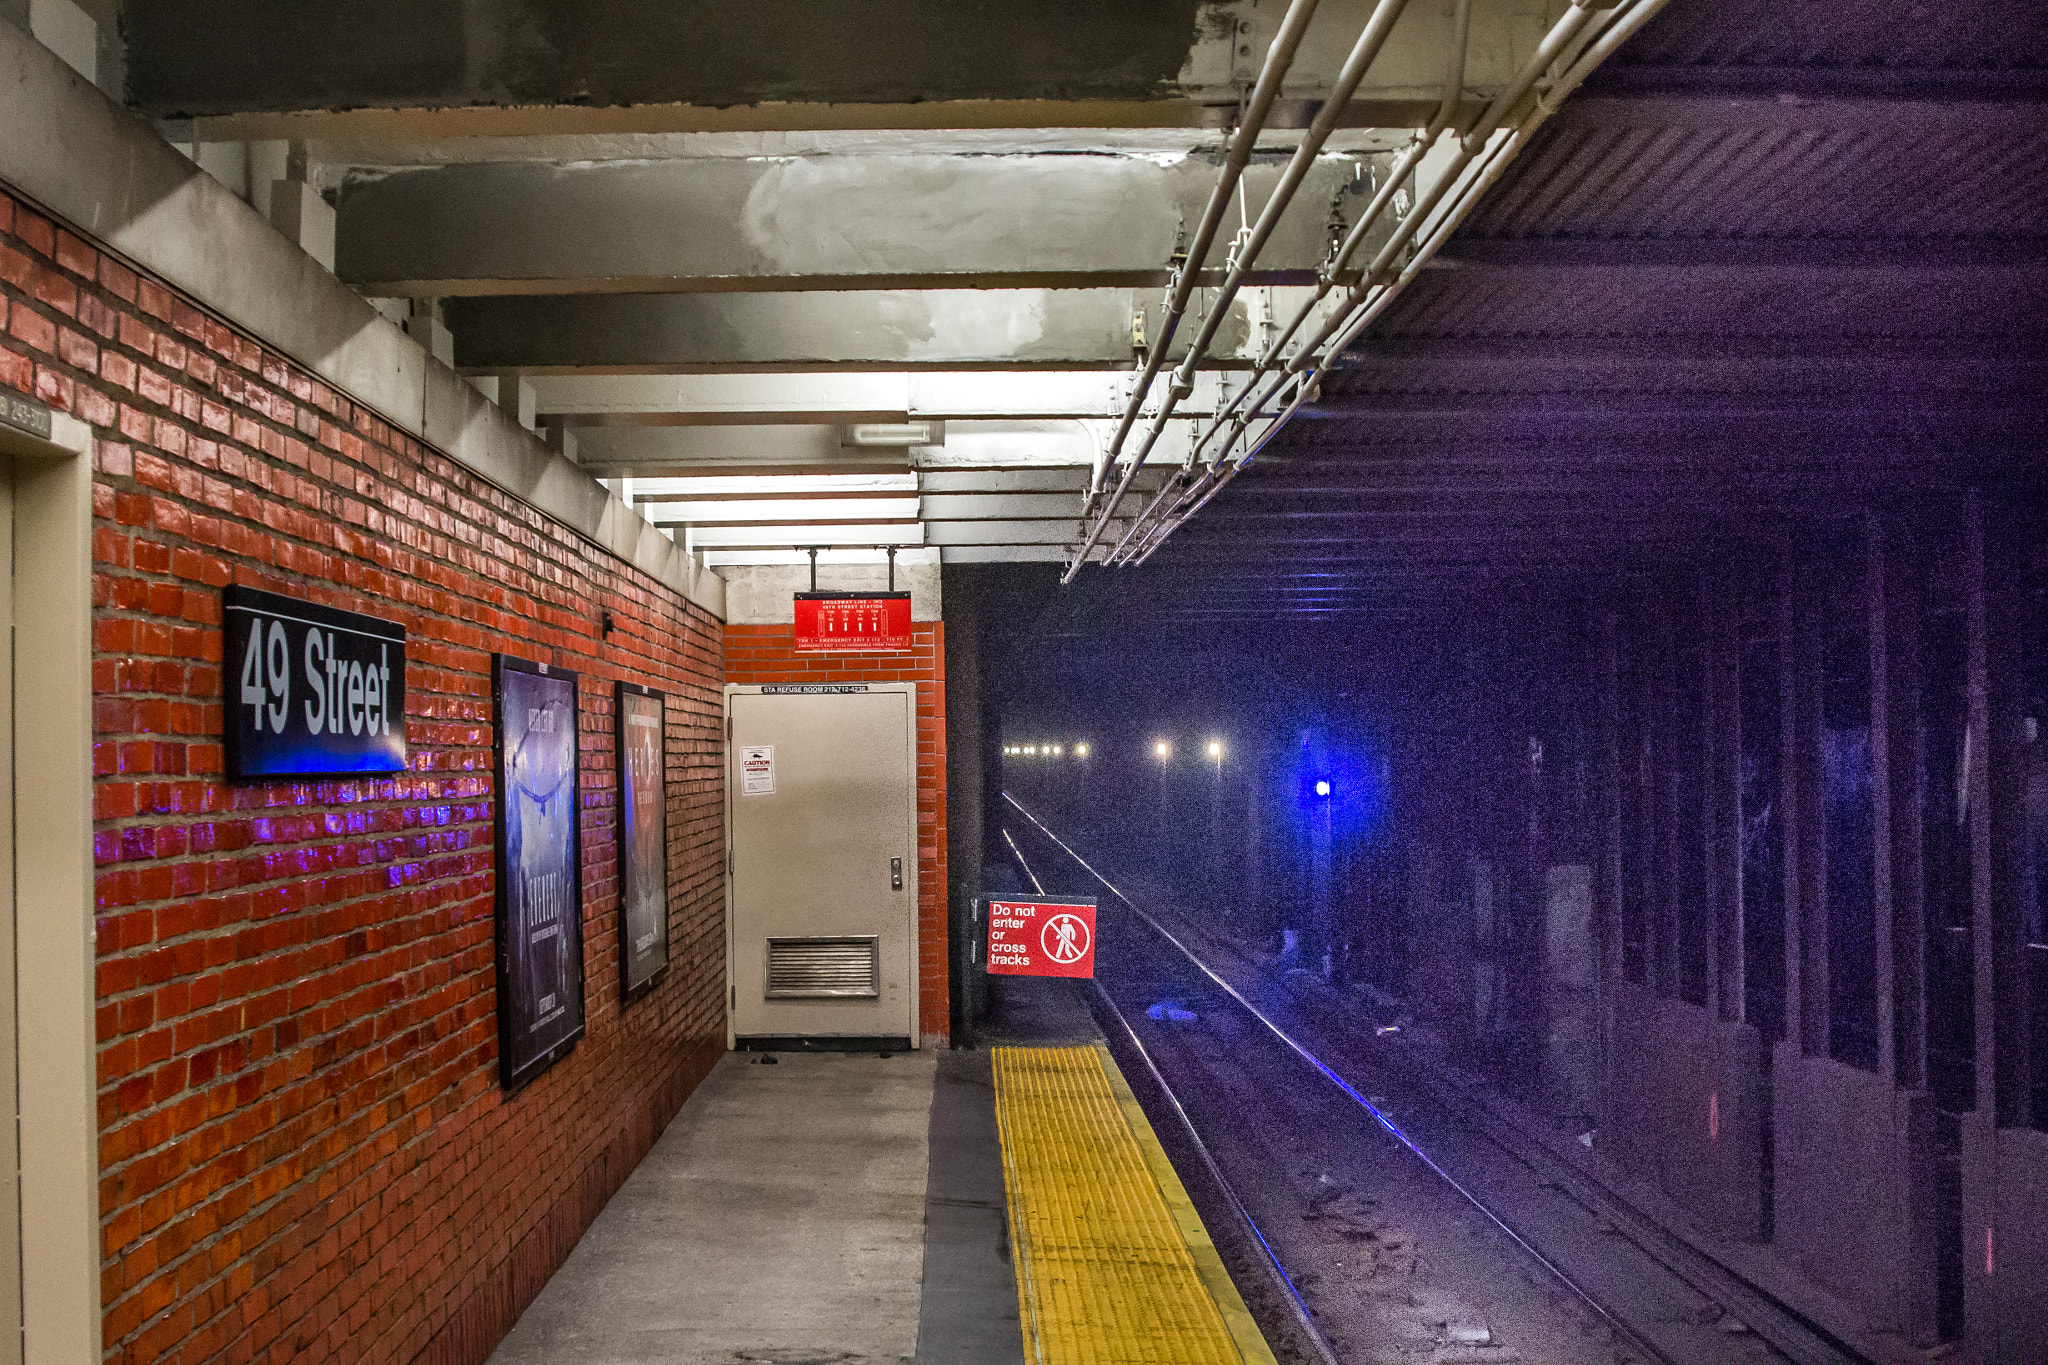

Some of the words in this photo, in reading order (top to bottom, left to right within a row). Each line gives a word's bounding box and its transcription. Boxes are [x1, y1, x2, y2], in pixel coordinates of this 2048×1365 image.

[241, 618, 290, 734] 49
[304, 627, 390, 737] Street
[992, 904, 1011, 916] Do
[1015, 906, 1036, 917] not
[992, 917, 1025, 929] enter
[991, 930, 1005, 940] or
[991, 943, 1026, 953] cross
[991, 953, 1030, 966] tracks
